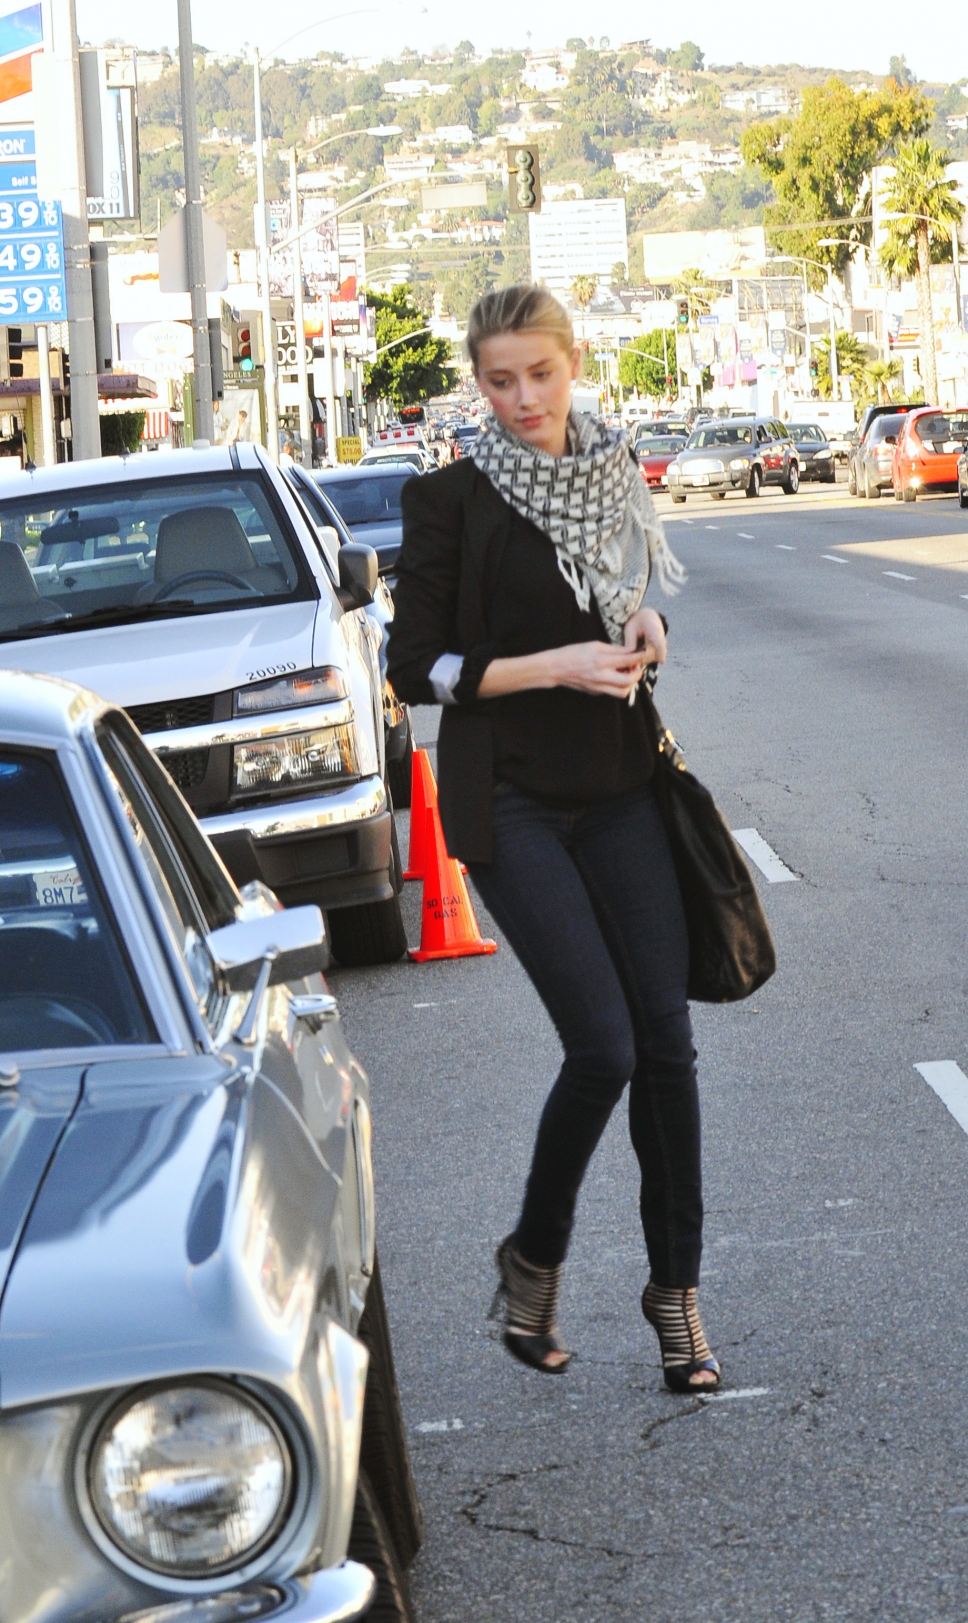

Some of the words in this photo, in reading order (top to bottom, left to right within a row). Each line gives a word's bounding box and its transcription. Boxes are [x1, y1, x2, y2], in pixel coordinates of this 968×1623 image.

[0, 138, 25, 155] ON
[0, 243, 41, 271] 49
[0, 286, 44, 315] 59
[246, 661, 297, 681] 20090
[426, 898, 438, 909] SO
[442, 895, 463, 906] CAL
[433, 908, 457, 919] GAS
